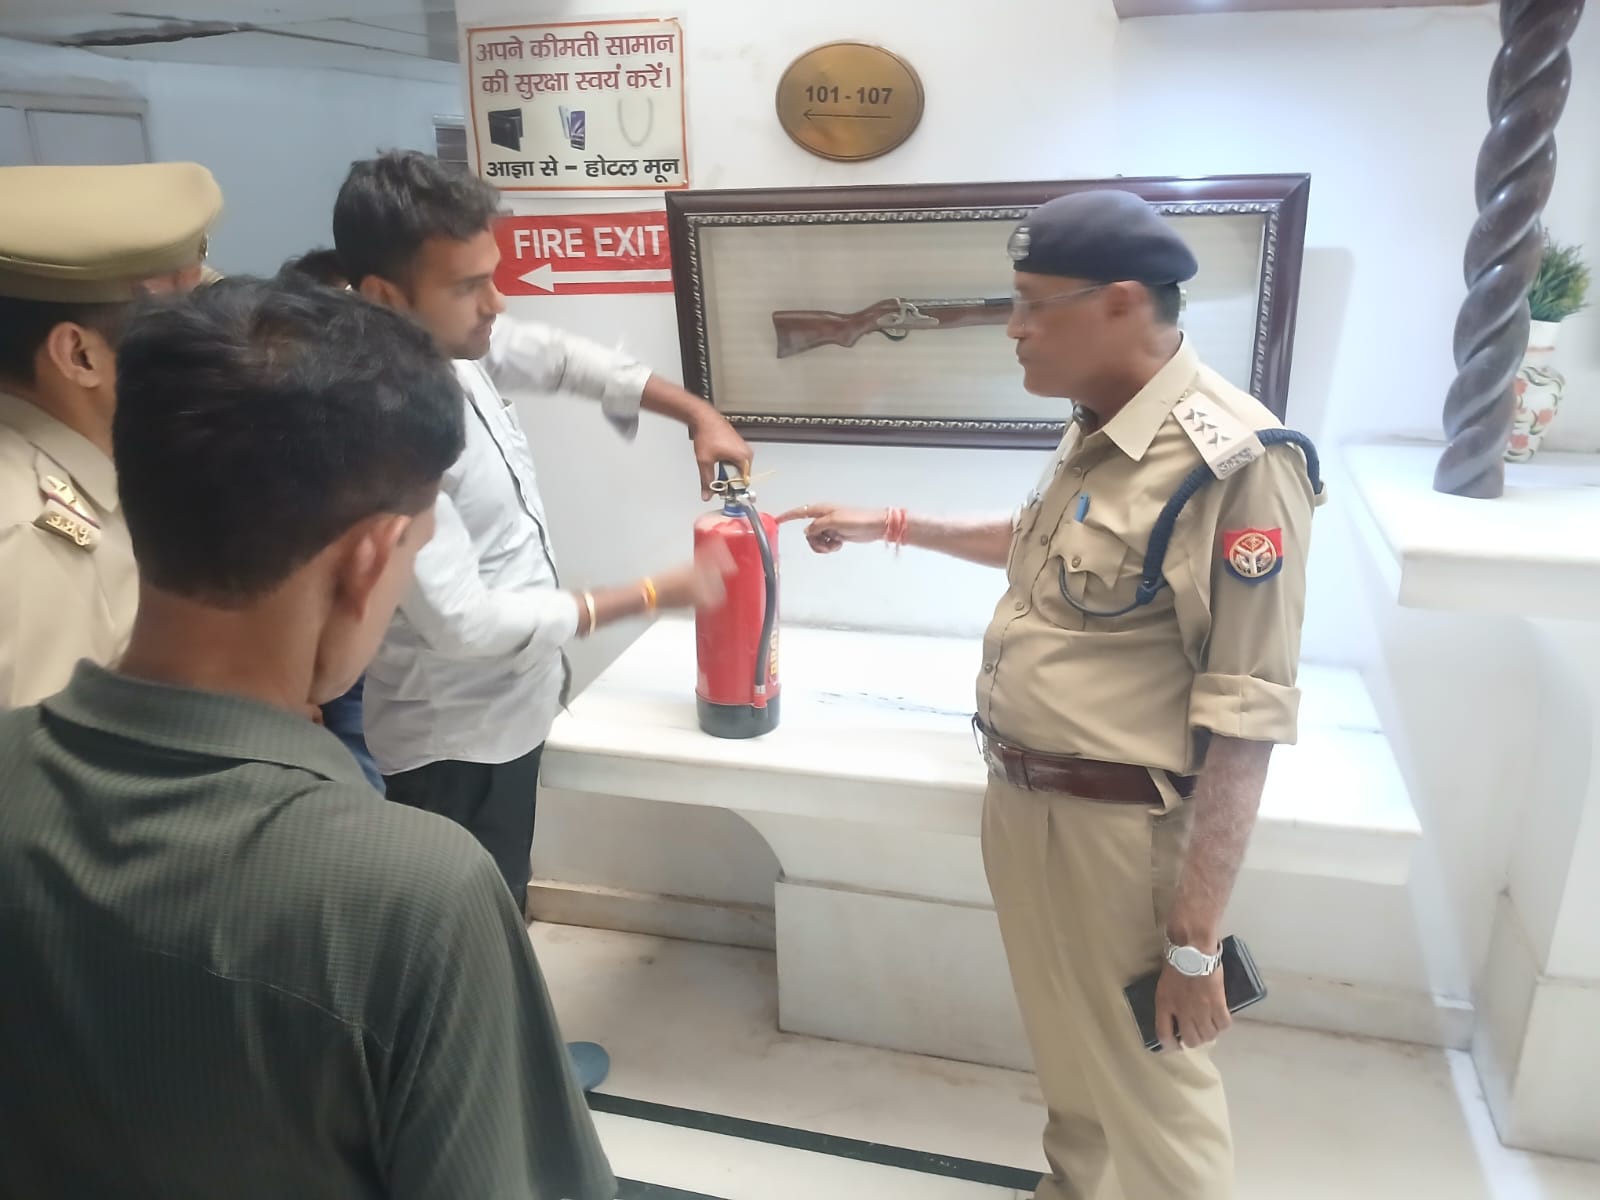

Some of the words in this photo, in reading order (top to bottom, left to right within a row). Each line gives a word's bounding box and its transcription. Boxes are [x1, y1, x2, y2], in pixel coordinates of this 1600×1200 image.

[476, 35, 523, 61] अपने
[530, 32, 599, 58] कीमती
[605, 34, 675, 56] सामान
[481, 69, 508, 93] की
[514, 73, 569, 100] सुरक्षा
[575, 63, 622, 91] स्वयं
[805, 85, 839, 103] 101
[856, 87, 893, 105] 107
[486, 161, 534, 180] आज्ञा
[539, 155, 559, 177] से
[584, 154, 639, 178] होटल
[643, 158, 680, 183] मून
[513, 228, 586, 259] FIRE
[593, 225, 665, 258] EXIT
